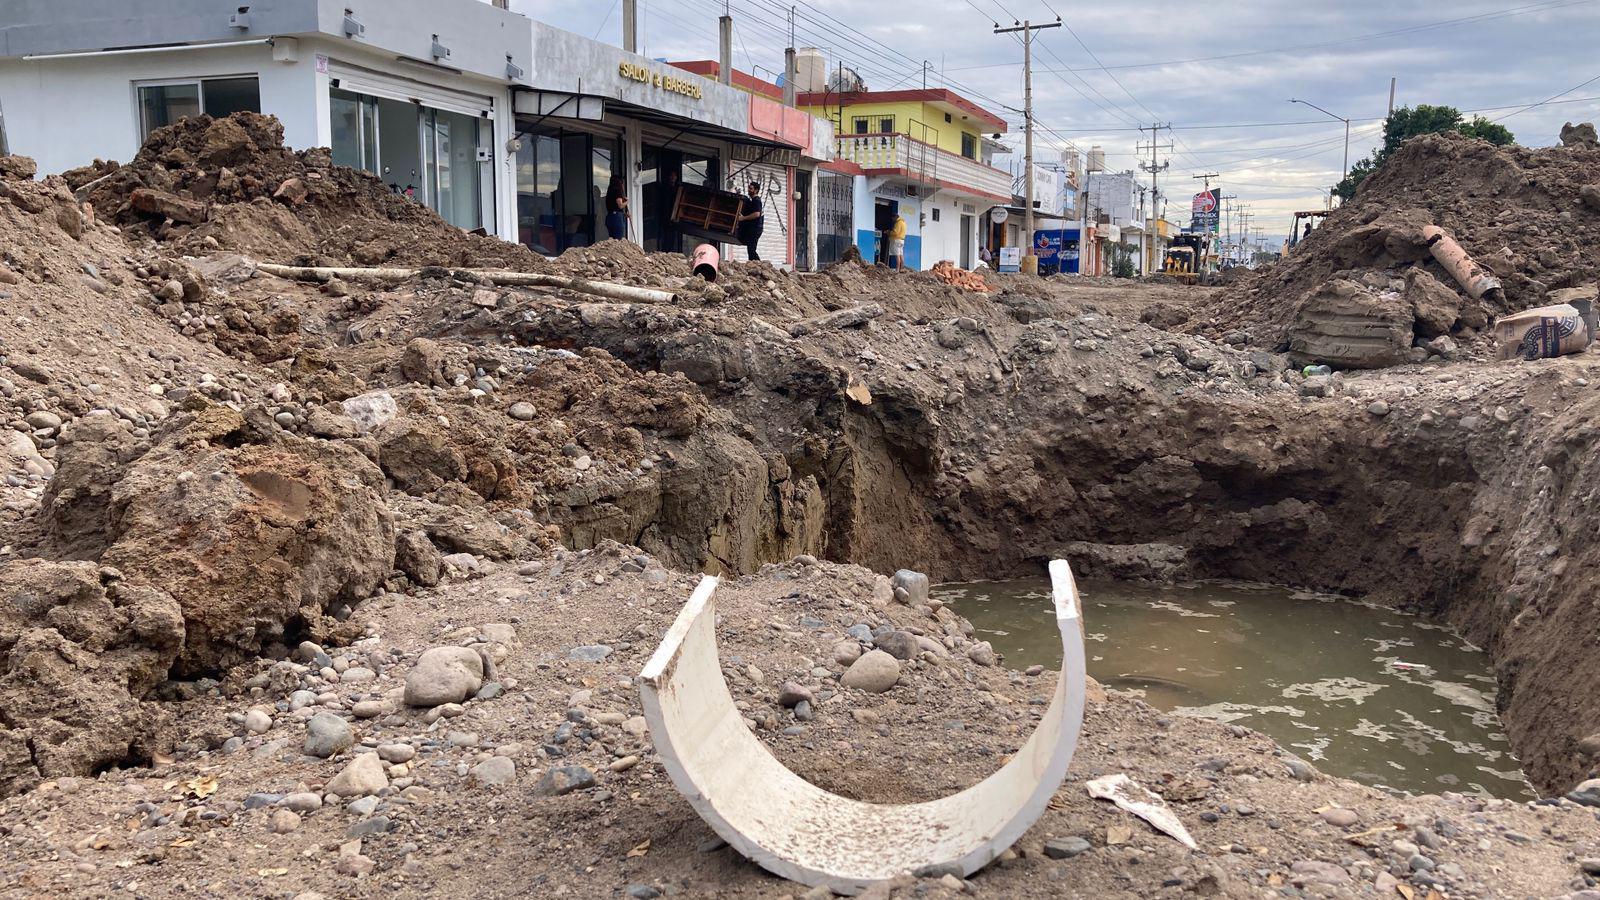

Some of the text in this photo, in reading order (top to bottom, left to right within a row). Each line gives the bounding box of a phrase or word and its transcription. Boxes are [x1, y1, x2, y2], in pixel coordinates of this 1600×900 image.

[620, 63, 702, 99] SALON & BARBERIA
